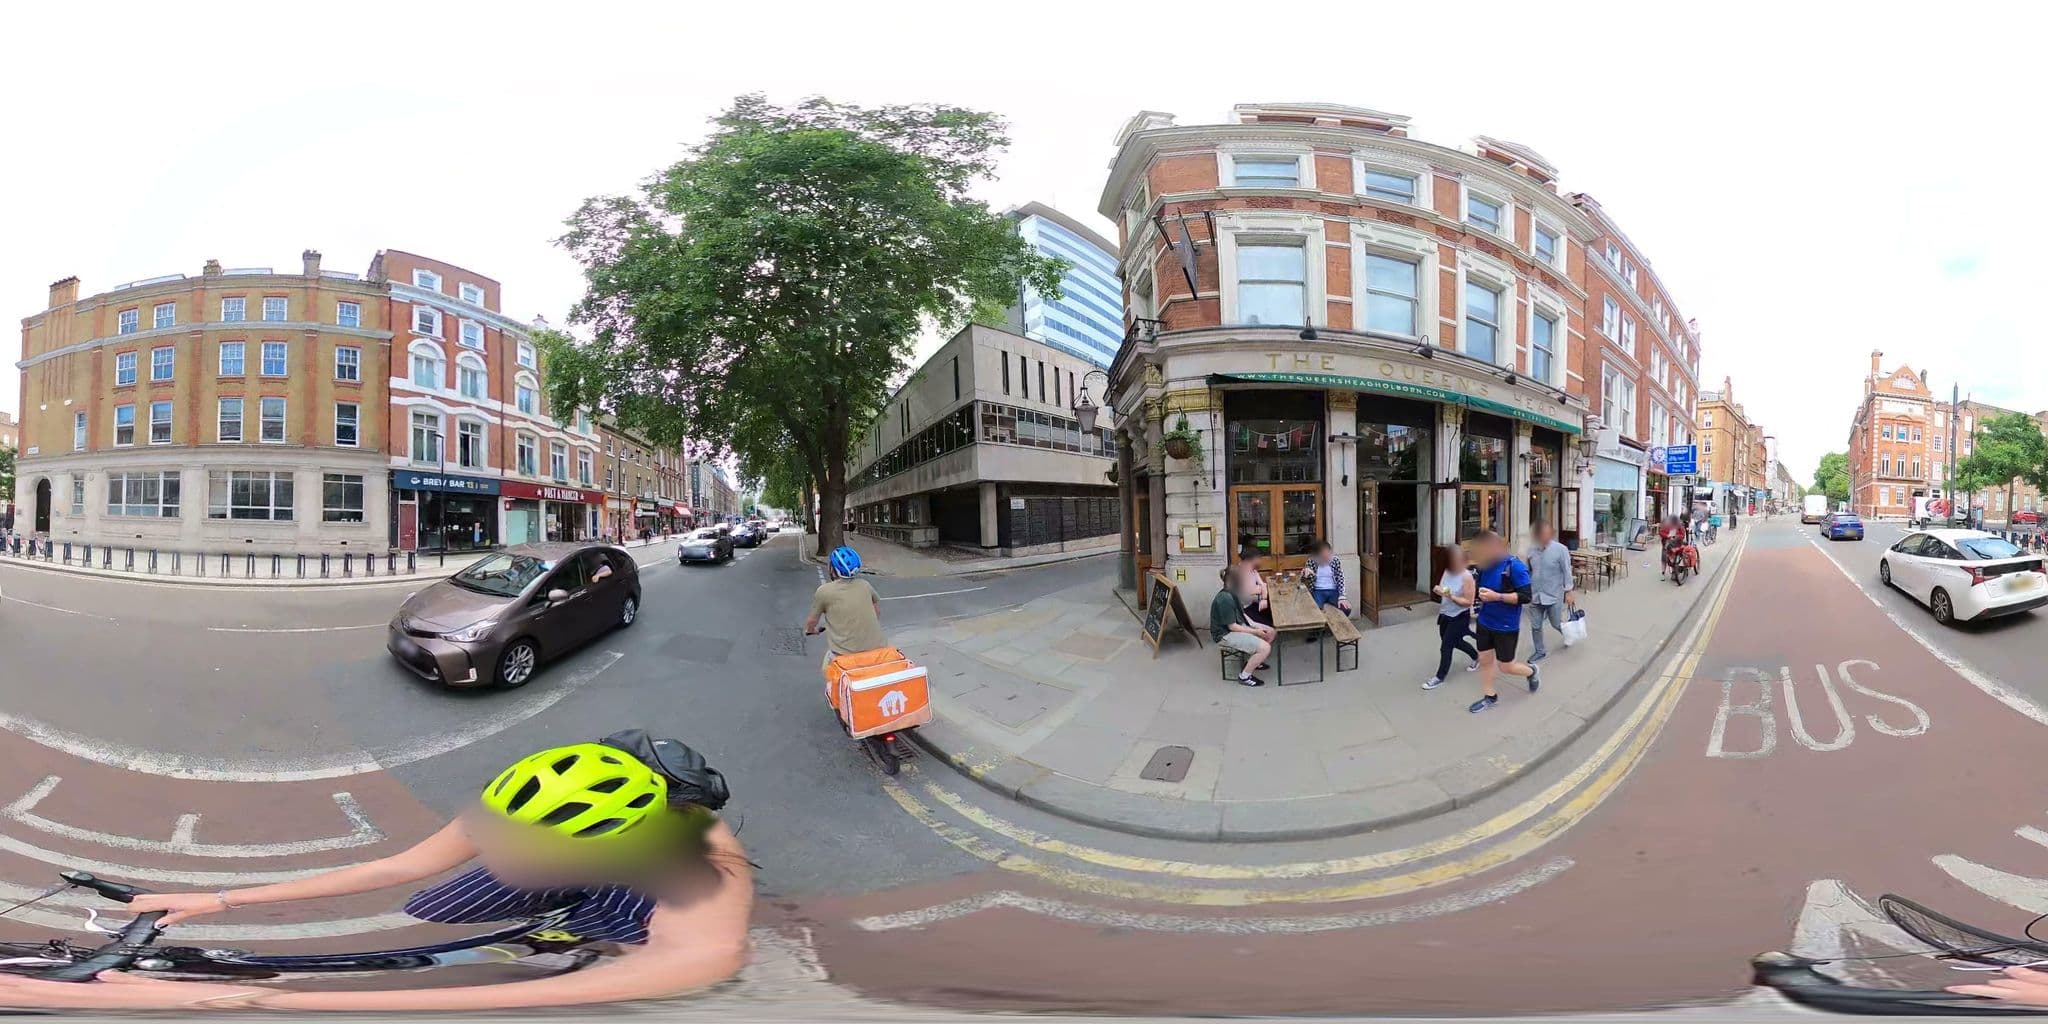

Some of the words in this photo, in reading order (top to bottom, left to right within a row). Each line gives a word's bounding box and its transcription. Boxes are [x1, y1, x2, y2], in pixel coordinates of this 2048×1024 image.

[1264, 352, 1336, 371] THE
[423, 478, 447, 487] BREW
[449, 479, 465, 488] BAR
[1176, 569, 1186, 581] H
[1706, 658, 1931, 758] BUS
